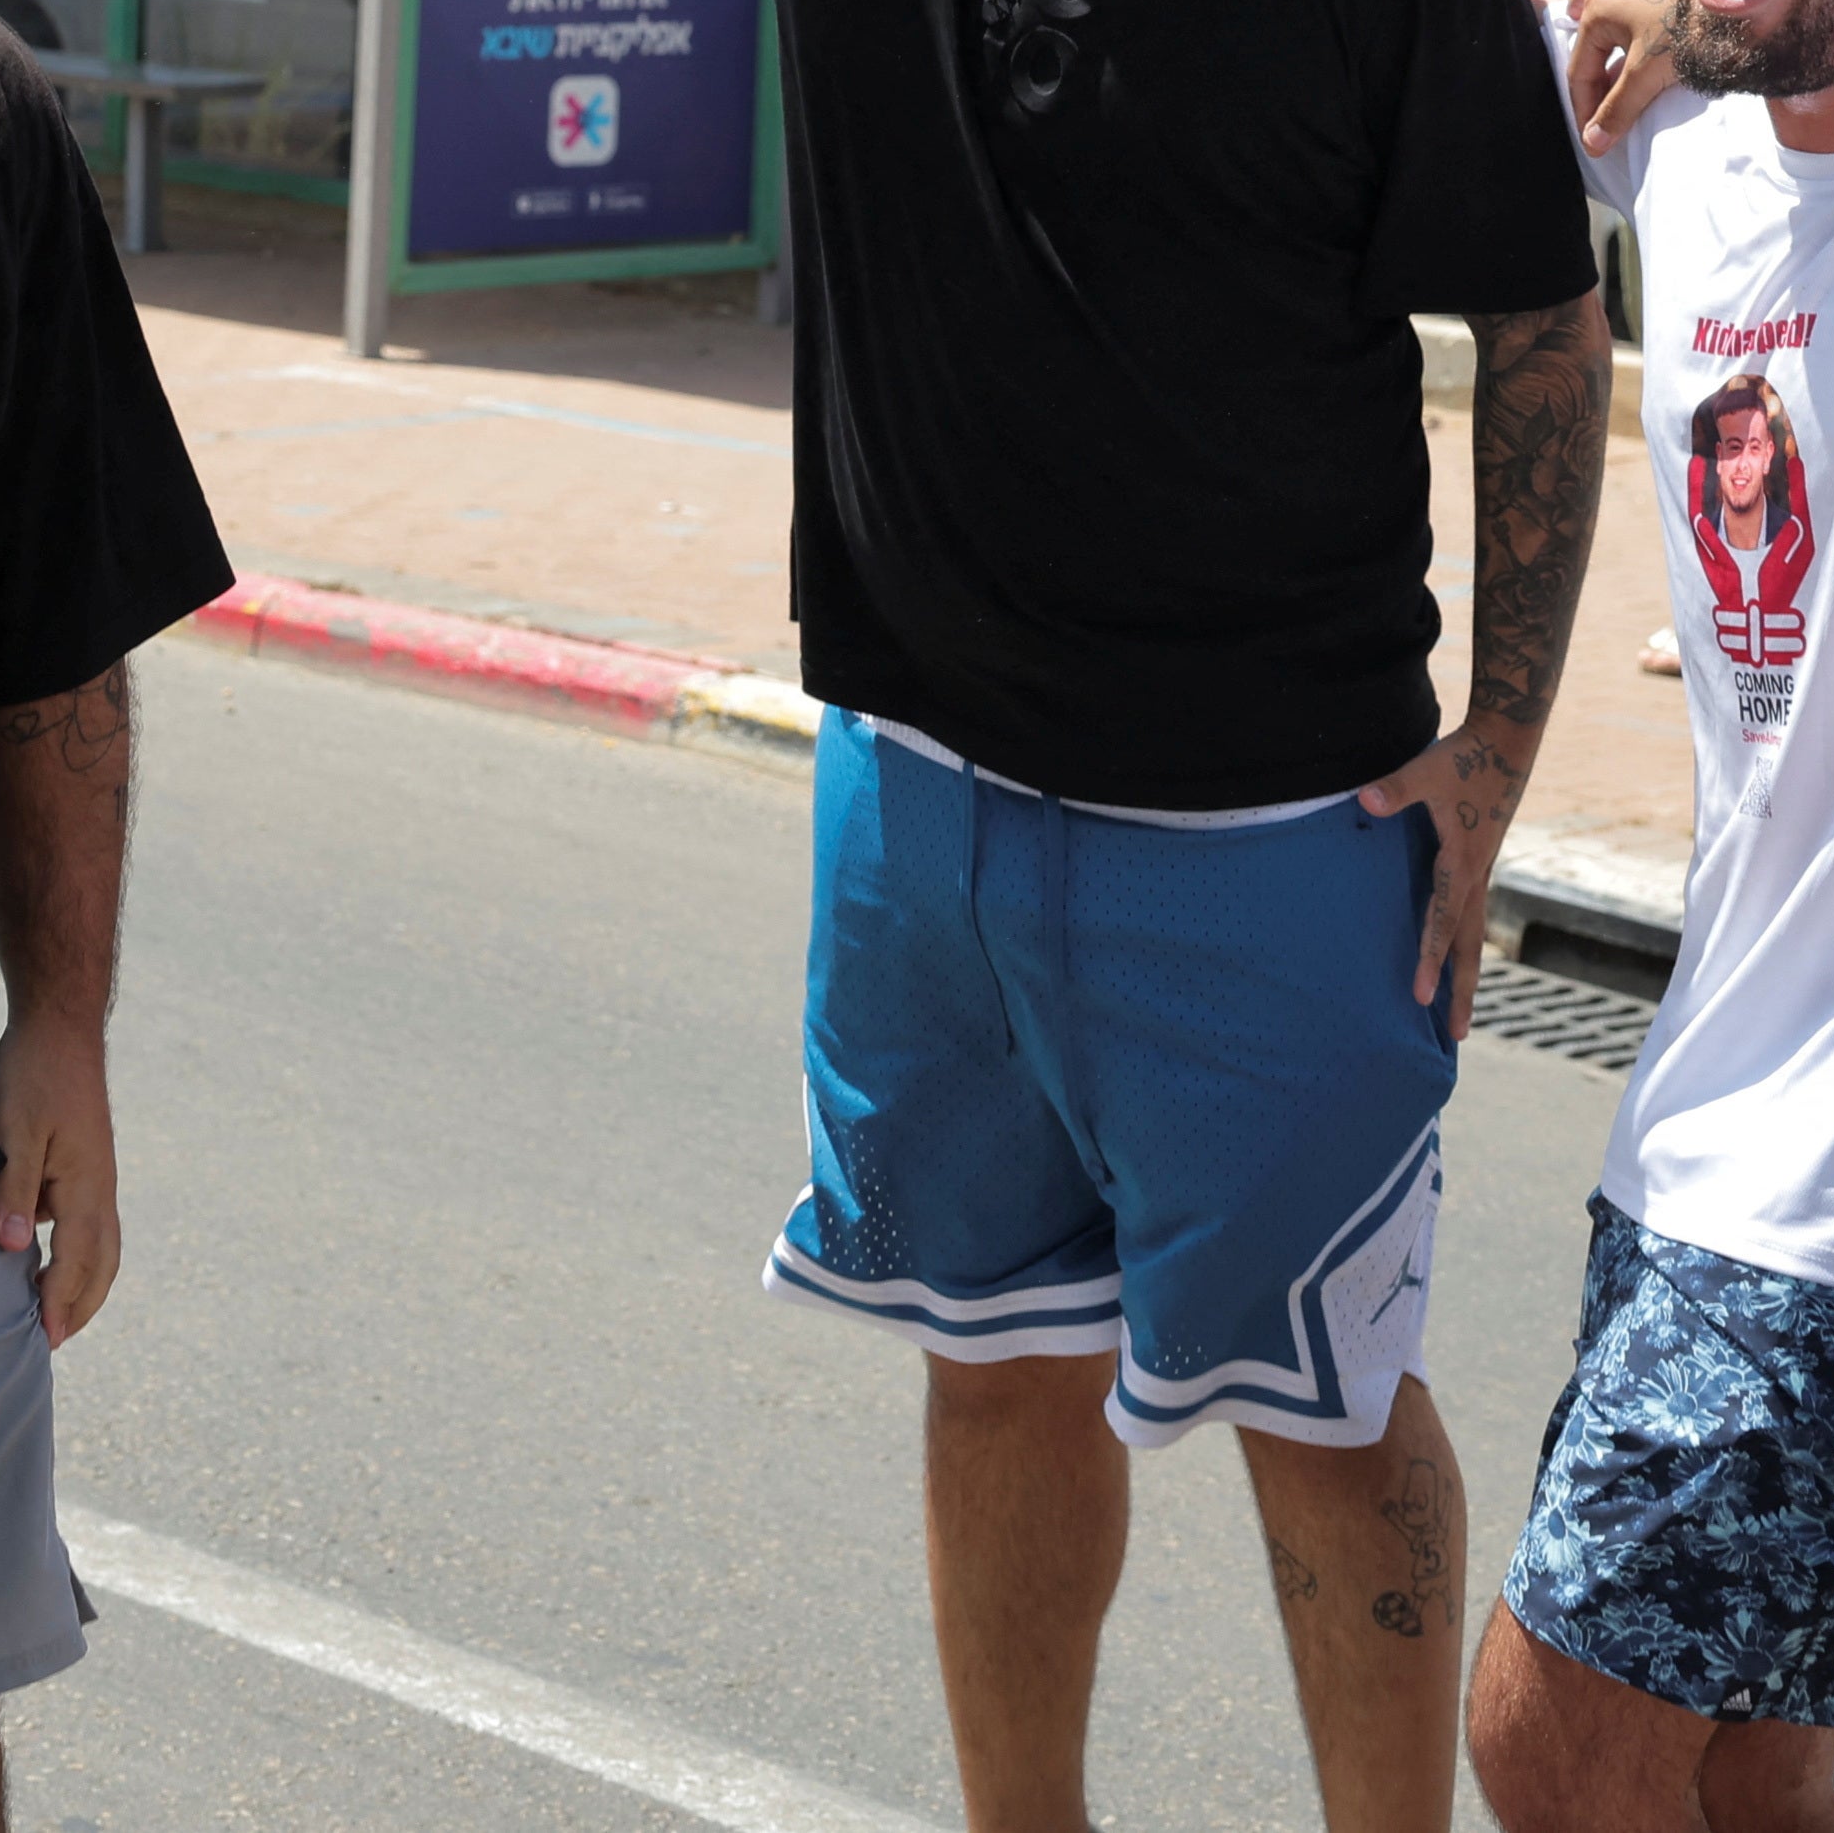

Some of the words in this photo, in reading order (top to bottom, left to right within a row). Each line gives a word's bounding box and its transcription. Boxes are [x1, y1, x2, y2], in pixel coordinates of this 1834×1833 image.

[1692, 312, 1817, 358] Kidnaped!
[1734, 671, 1794, 695] COMING
[1738, 694, 1793, 727] HOME
